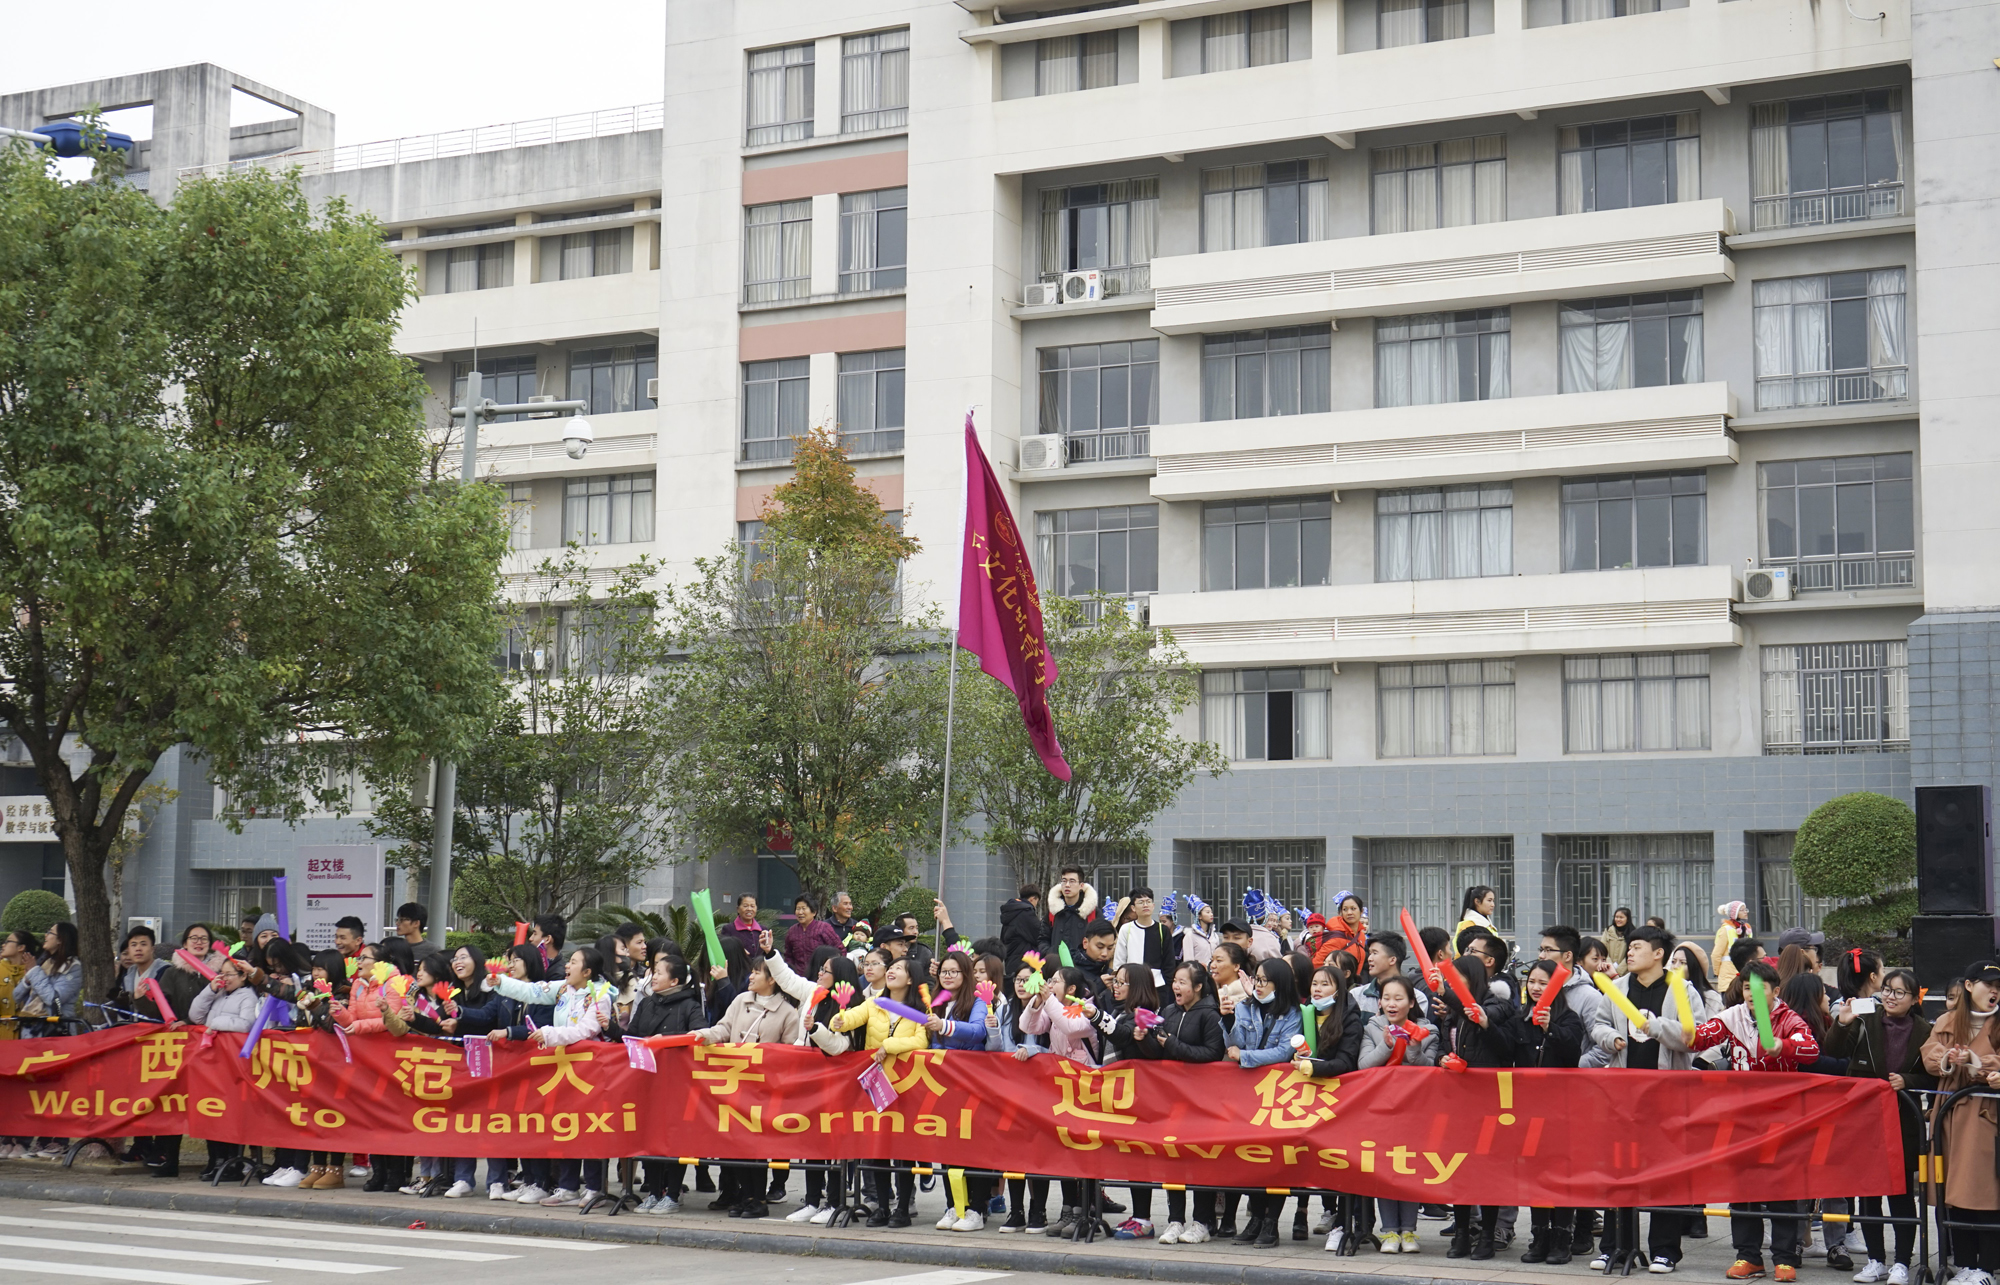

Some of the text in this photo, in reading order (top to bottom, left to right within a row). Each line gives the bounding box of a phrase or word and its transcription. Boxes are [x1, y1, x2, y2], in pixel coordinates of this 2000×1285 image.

[308, 858, 344, 872] 起文楼
[307, 873, 351, 881] Qiwen Building
[29, 1090, 1468, 1184] Welcome to Guangxi Normal University
